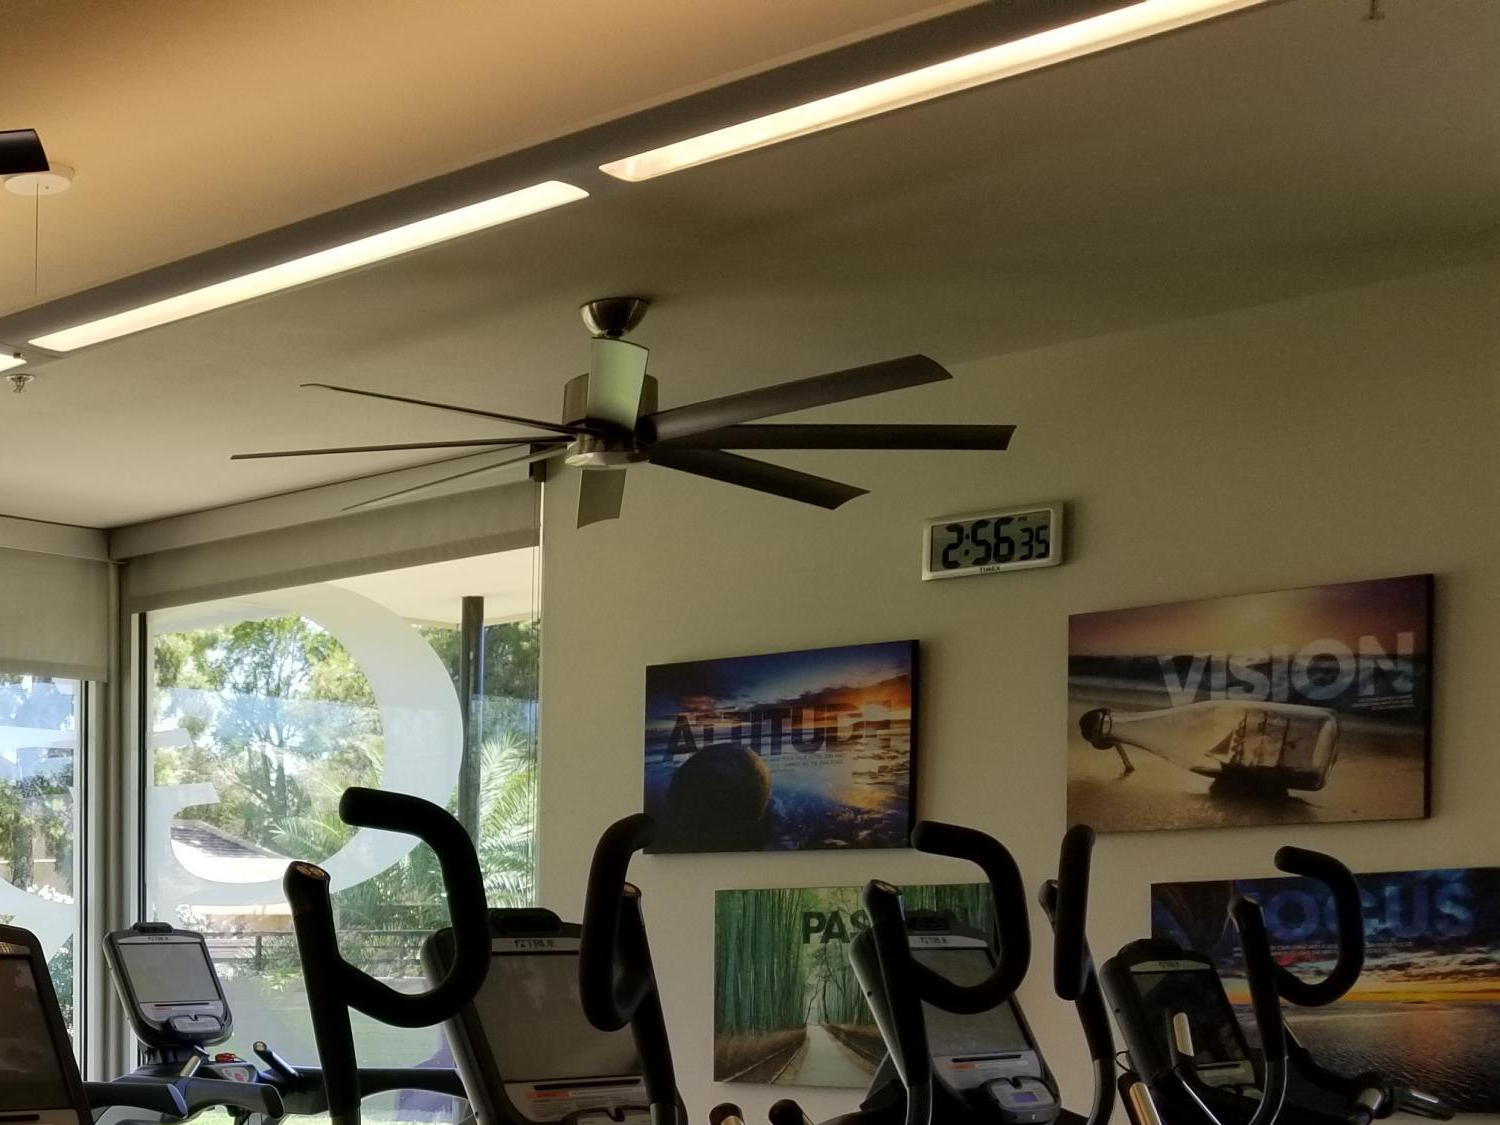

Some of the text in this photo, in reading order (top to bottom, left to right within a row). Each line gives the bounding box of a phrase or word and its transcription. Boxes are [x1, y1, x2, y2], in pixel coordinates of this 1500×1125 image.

[942, 516, 1049, 569] 2:56 35
[1157, 632, 1414, 707] VISION
[663, 700, 891, 763] ATTITUDE
[1244, 882, 1476, 941] OCUS
